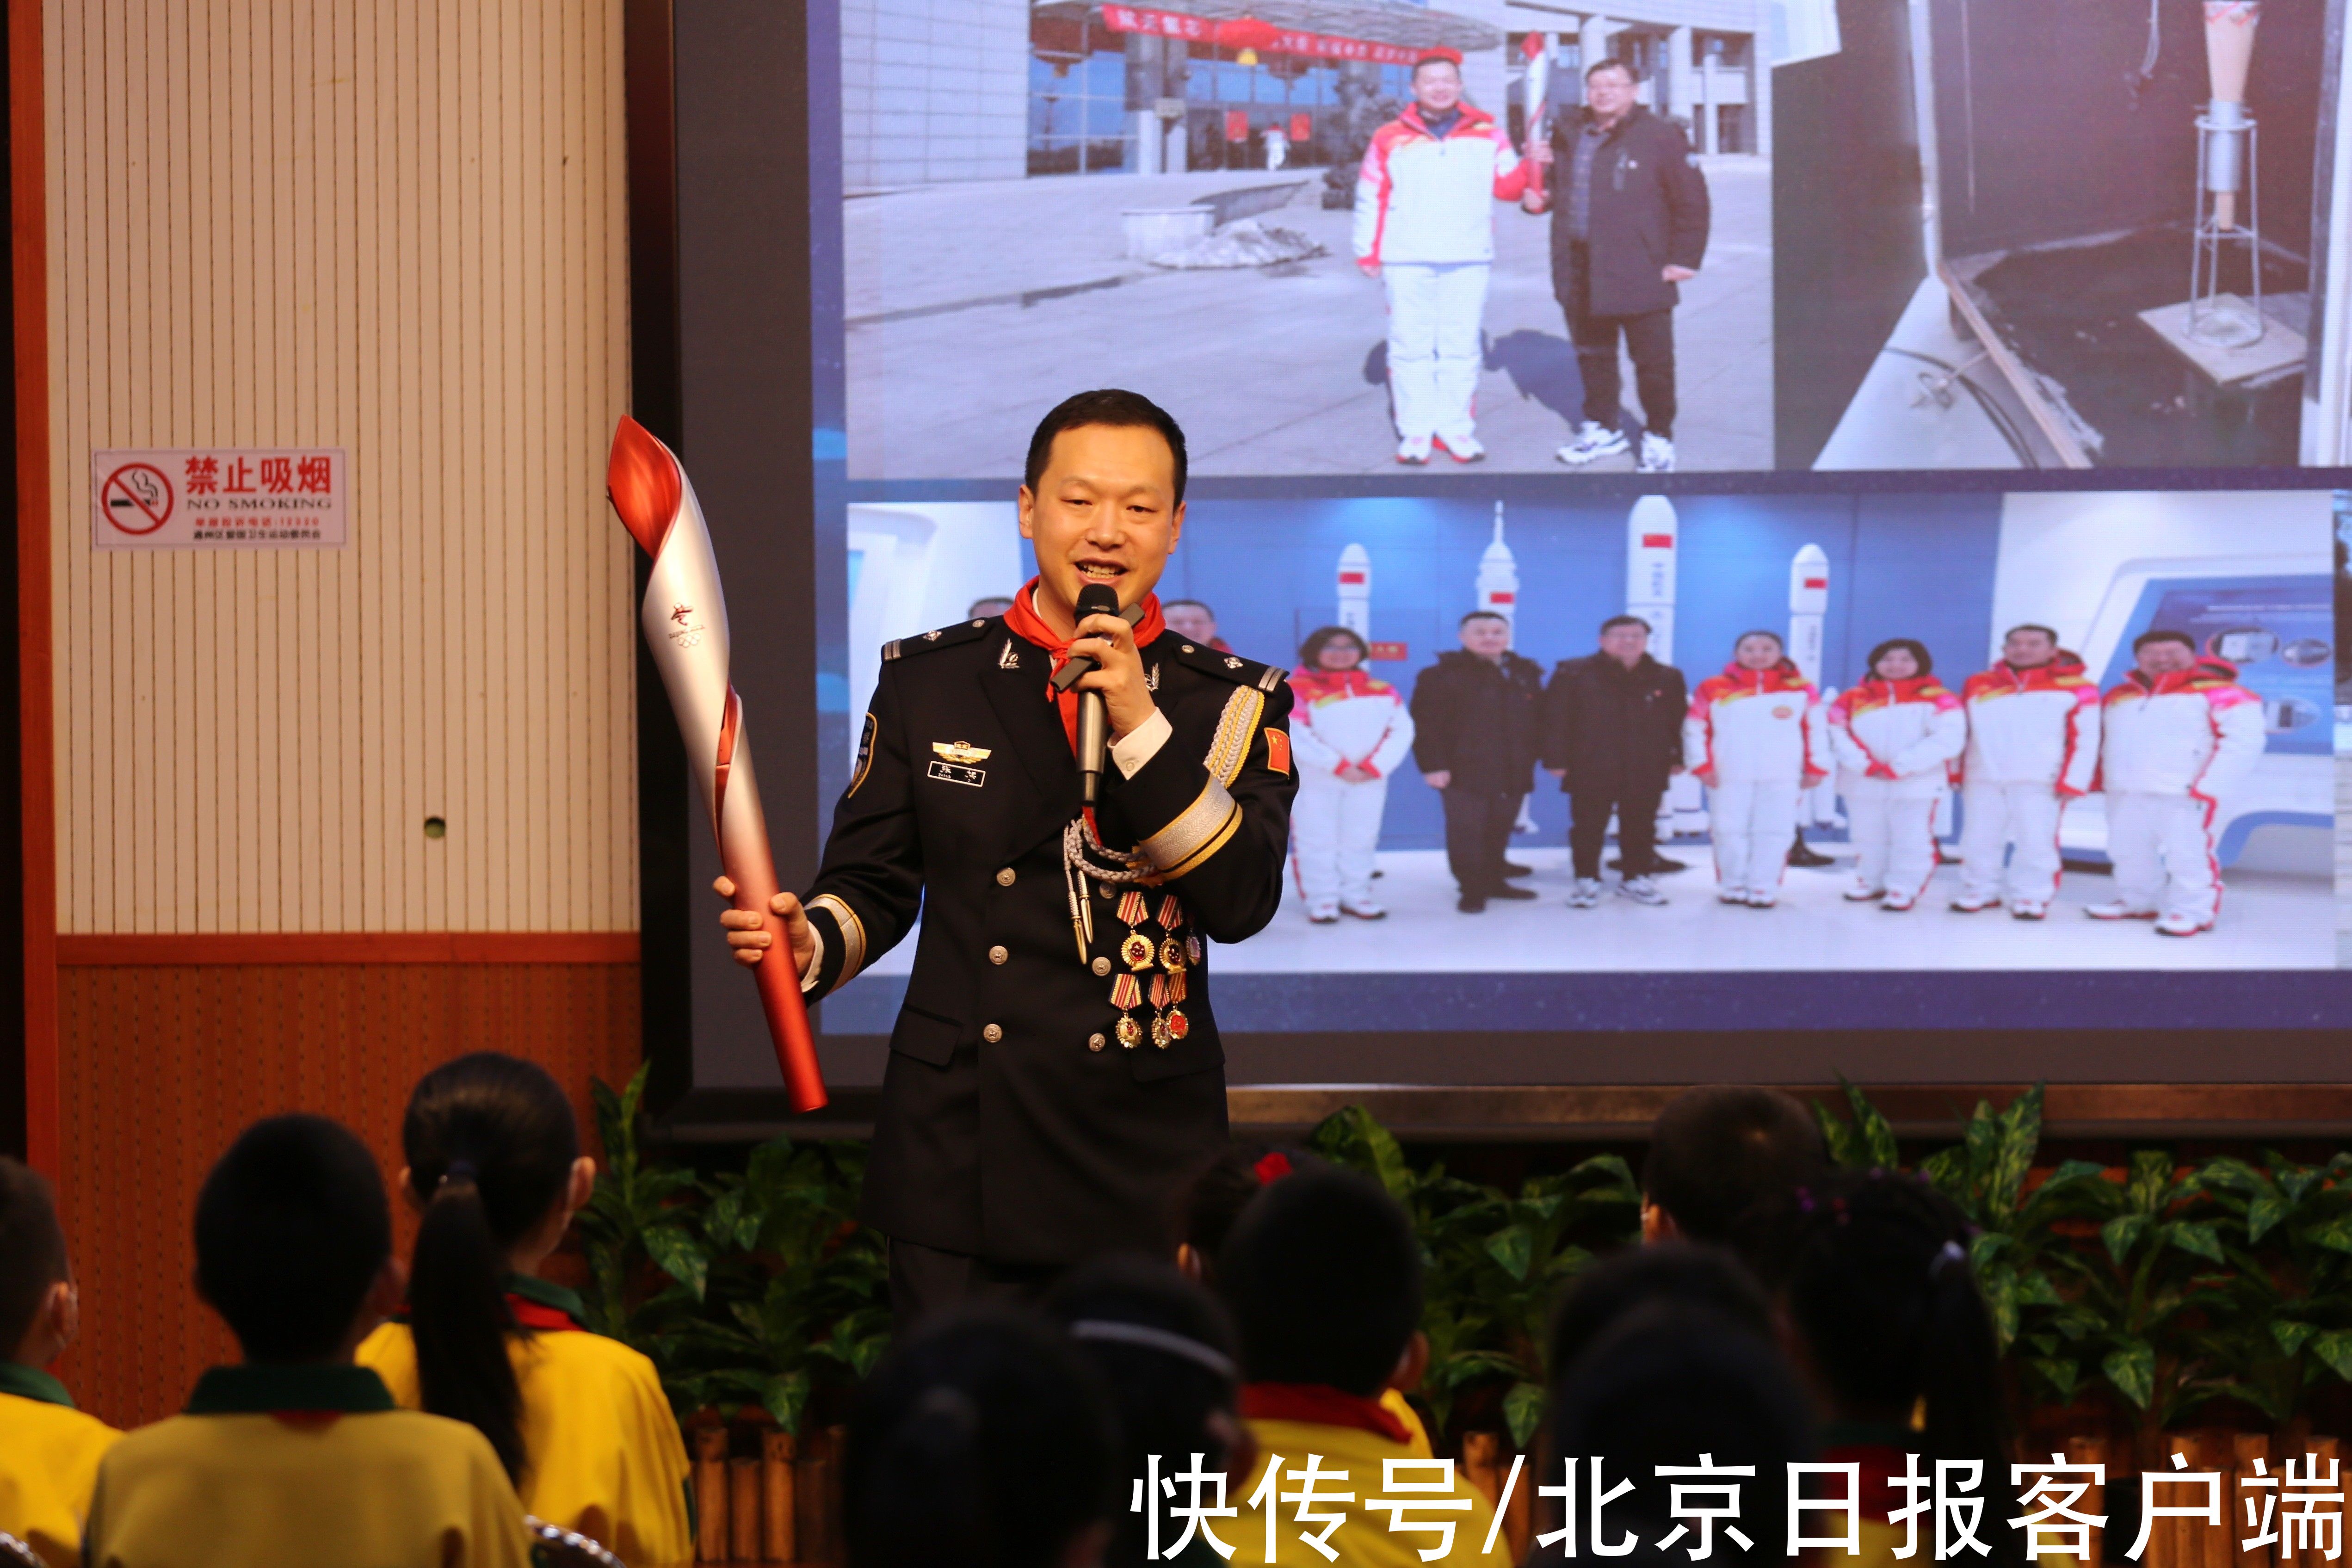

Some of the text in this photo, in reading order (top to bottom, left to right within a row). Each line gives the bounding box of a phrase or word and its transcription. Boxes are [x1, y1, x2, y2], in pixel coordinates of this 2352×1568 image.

[185, 456, 331, 494] 禁止吸烟
[187, 499, 331, 510] NO SMOKING
